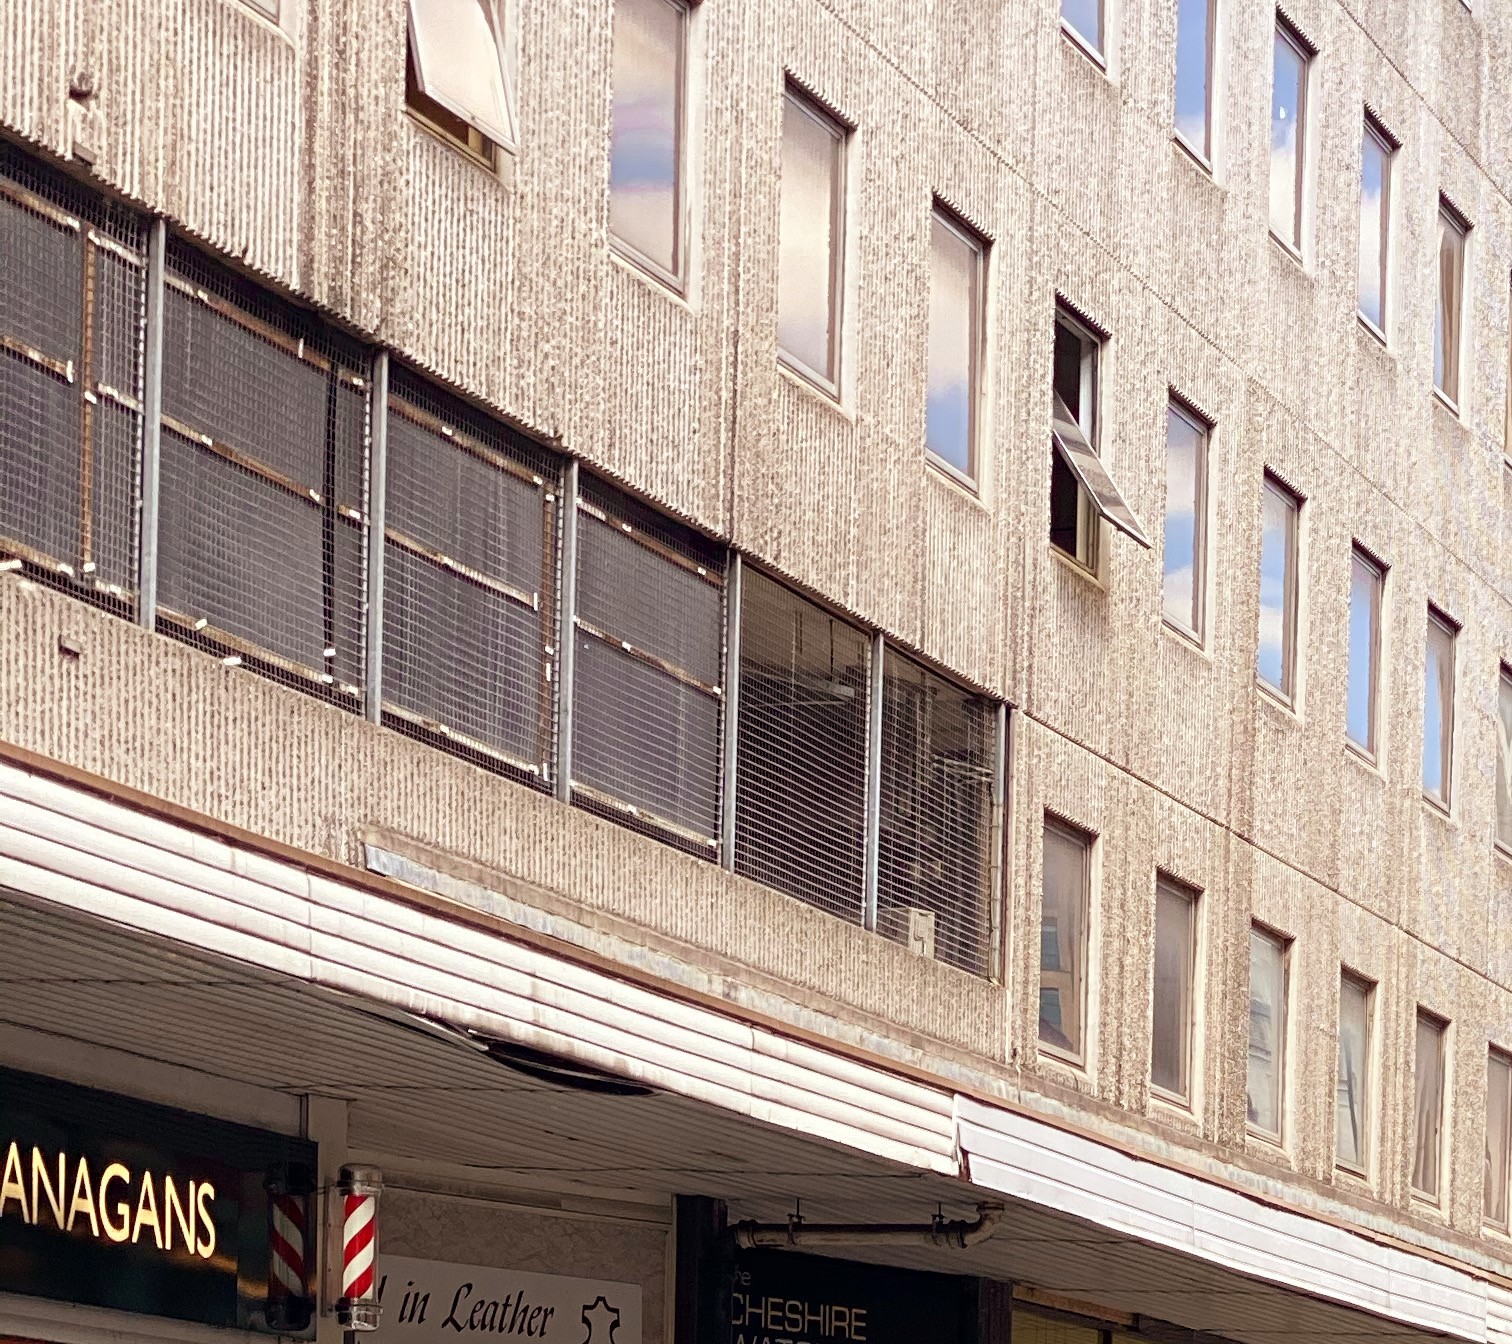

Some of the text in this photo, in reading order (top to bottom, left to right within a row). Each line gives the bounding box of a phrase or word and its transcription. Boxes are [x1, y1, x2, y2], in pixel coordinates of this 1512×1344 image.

[0, 1141, 216, 1259] ANAGANS
[399, 1281, 431, 1325] in
[441, 1282, 555, 1338] Leather
[731, 1293, 867, 1341] CHESHIRE
